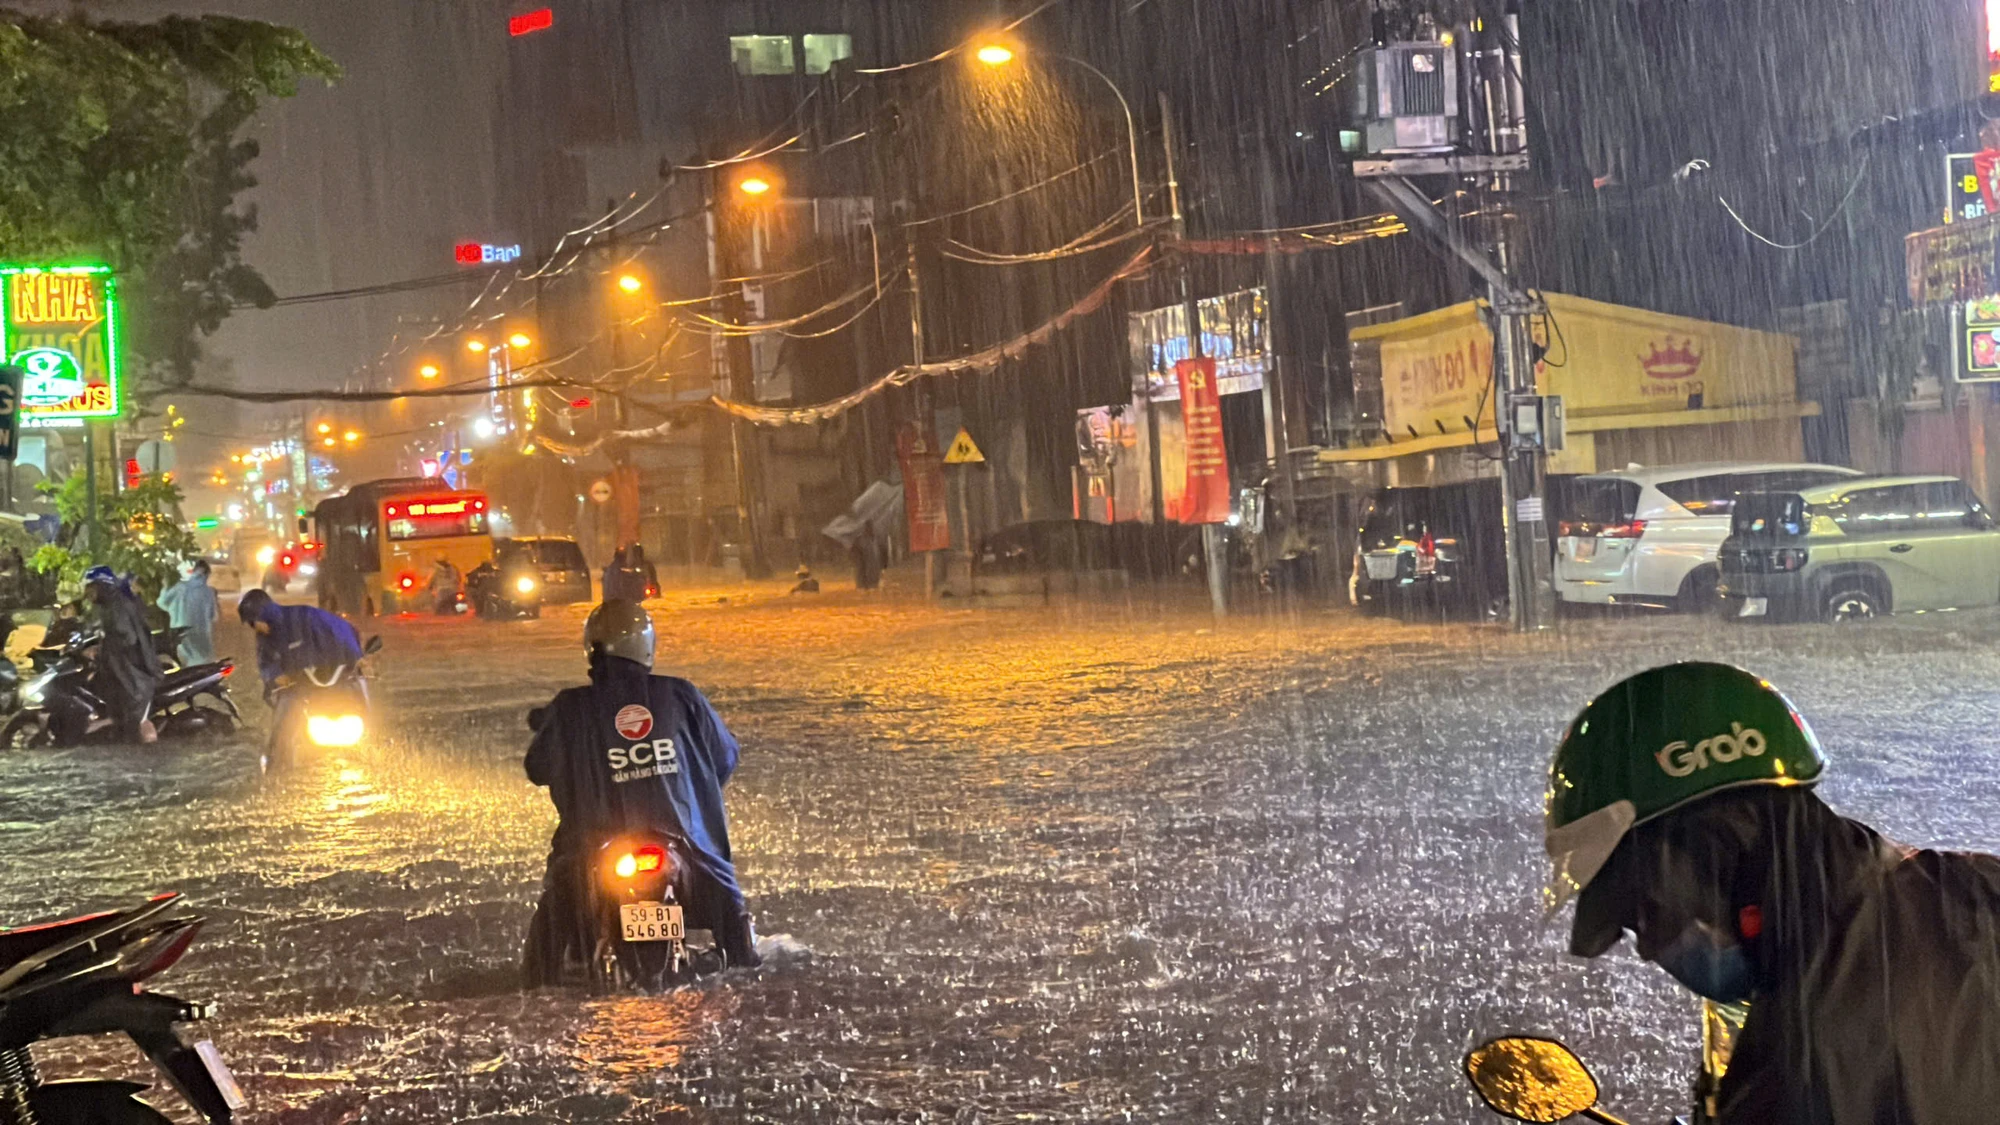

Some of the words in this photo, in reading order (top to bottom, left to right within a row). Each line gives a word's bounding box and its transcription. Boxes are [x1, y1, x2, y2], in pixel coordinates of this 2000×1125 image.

[607, 738, 677, 769] SCB
[1655, 721, 1767, 777] Grab
[630, 907, 671, 922] 59-B1
